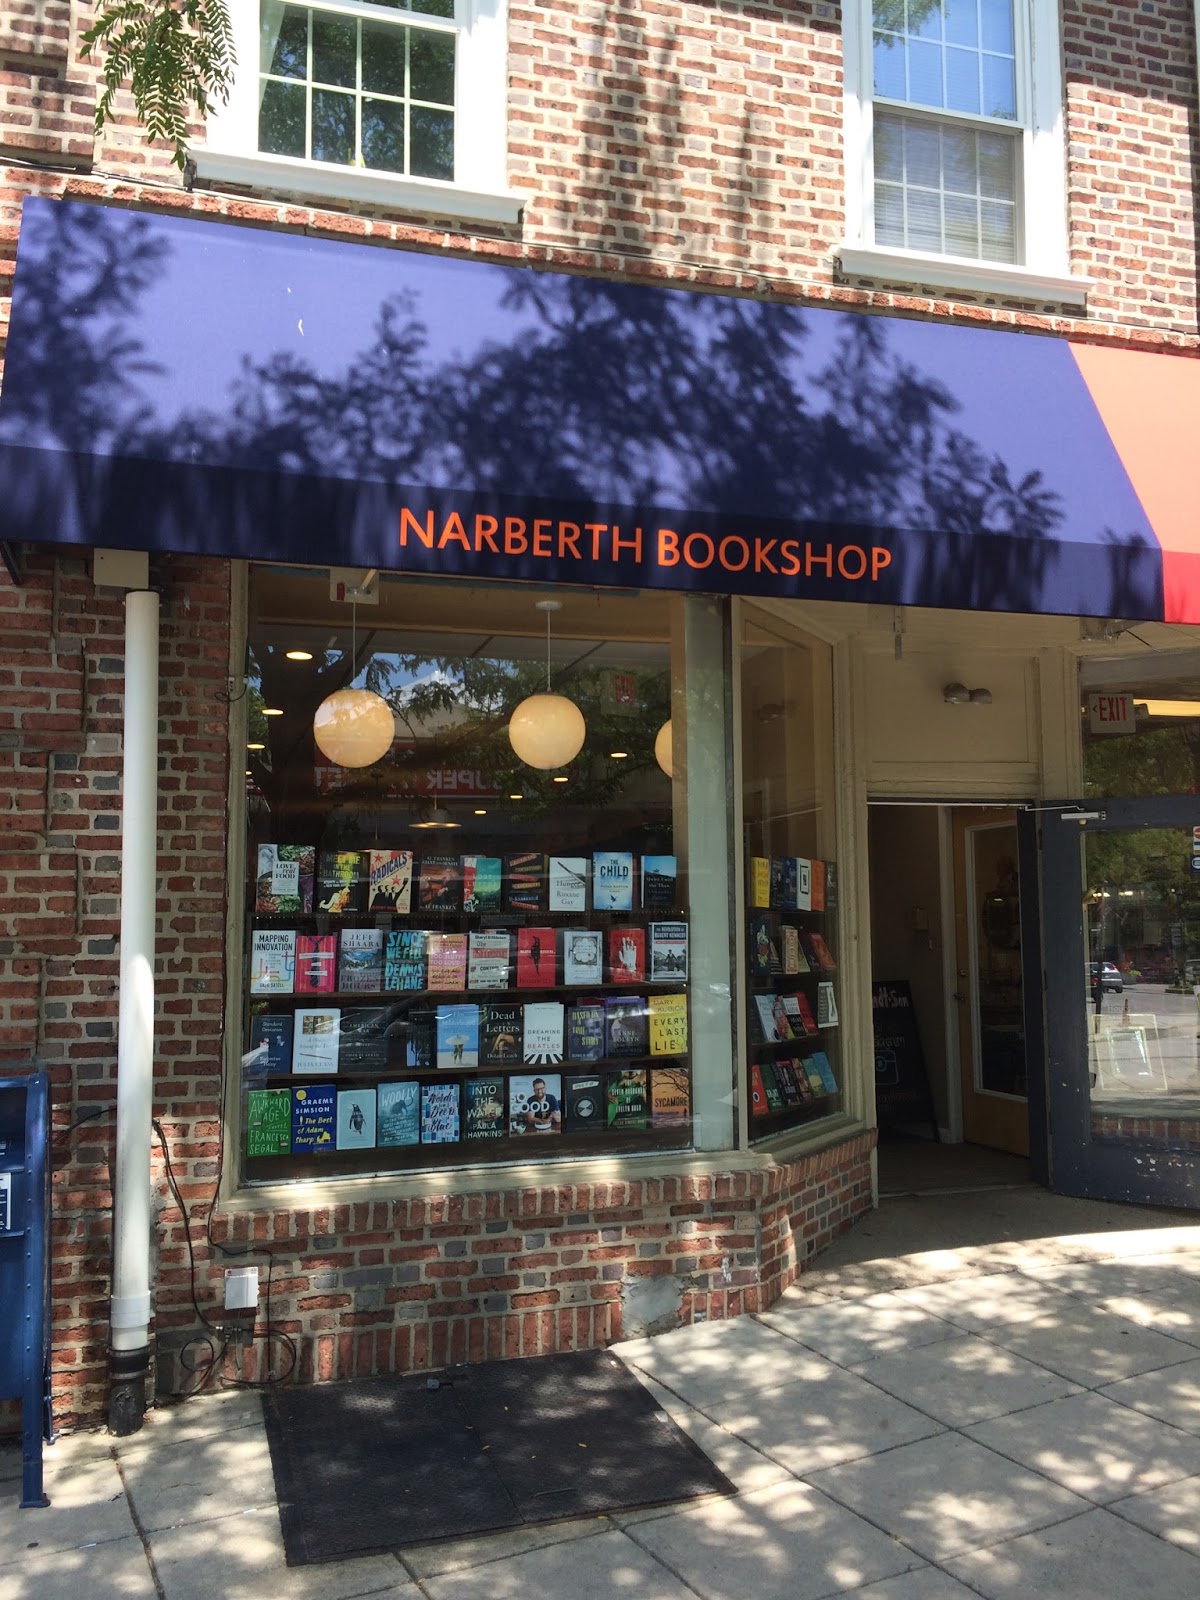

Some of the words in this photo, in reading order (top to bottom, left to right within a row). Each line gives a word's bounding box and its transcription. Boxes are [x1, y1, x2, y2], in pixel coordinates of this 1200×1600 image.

[400, 507, 642, 563] NARBERTH
[658, 528, 892, 581] BOOKSHOP
[1099, 697, 1127, 721] EXIT
[370, 851, 408, 886] RADICALS
[600, 866, 629, 877] CHILD
[259, 935, 289, 943] MAPPING
[387, 931, 424, 947] SINCE
[254, 943, 293, 951] INNOVATION
[386, 947, 402, 959] WE
[403, 947, 423, 959] FELL
[385, 962, 424, 976] DENNIS
[385, 976, 424, 990] LEHANE
[491, 1011, 515, 1020] Dead
[654, 1017, 685, 1026] EVERY
[486, 1024, 520, 1033] Letters
[659, 1028, 685, 1036] LAST
[655, 1040, 676, 1051] LIE
[472, 1085, 497, 1095] INTO
[301, 1098, 333, 1106] GRAEME
[381, 1086, 418, 1107] WOOLLY
[428, 1092, 453, 1104] Words
[474, 1097, 494, 1106] THE
[510, 1092, 526, 1102] SO
[655, 1096, 688, 1108] SYCAMORE
[249, 1097, 290, 1120] AWKWARD
[295, 1106, 330, 1114] SIMSION
[467, 1107, 502, 1118] WATER
[510, 1101, 550, 1113] GOOD
[263, 1107, 280, 1122] AGE
[318, 1116, 333, 1124] Best
[428, 1119, 452, 1132] Blue
[472, 1122, 497, 1130] PAULA
[250, 1130, 289, 1143] FRANCESCA
[467, 1130, 502, 1139] HAWKINS
[295, 1137, 314, 1145] Sharp
[249, 1144, 278, 1155] SEGAL
